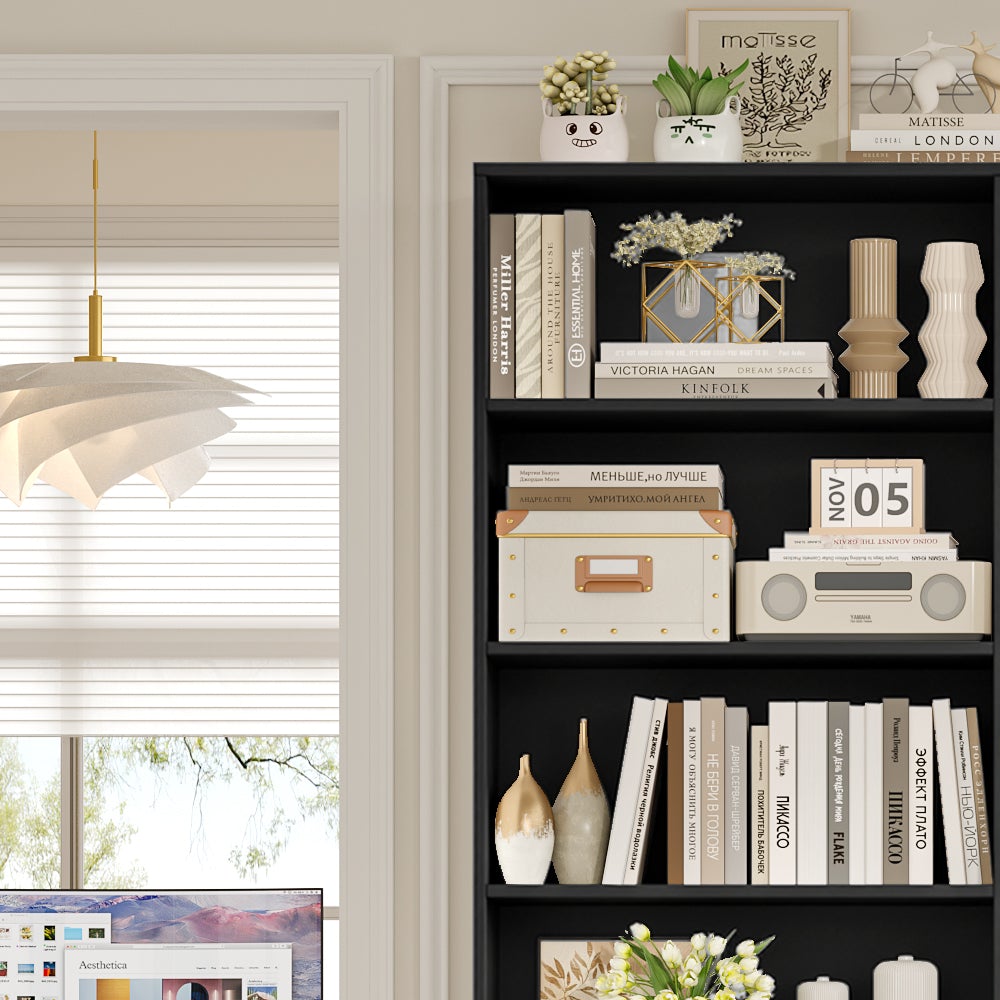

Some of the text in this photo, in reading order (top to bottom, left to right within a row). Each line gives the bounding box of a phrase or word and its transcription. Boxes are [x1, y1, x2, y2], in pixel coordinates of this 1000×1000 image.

[908, 116, 964, 127] MATISSE
[914, 135, 994, 146] LONDON
[571, 248, 581, 284] HOME
[500, 254, 512, 376] Miller Harris
[610, 366, 716, 376] VICTORIA HAGAN
[738, 366, 814, 375] DREAM SPACES
[682, 383, 750, 394] KINFOLK
[664, 471, 708, 482] ЛУЧШЕ
[672, 494, 705, 504] АНГЕЛ
[828, 477, 845, 521] NOV
[832, 538, 938, 546] GOING AGAINST THE GRAIN
[688, 734, 697, 760] МОГУ
[972, 745, 981, 775] РОСС
[688, 764, 697, 820] ОБЪЯСНИТЬ
[706, 752, 719, 860] НЕ БЕРИ В ГОЛОВУ
[915, 748, 927, 850] ЭФФЕКТ ПЛАТО
[629, 764, 655, 871] Религия черной водолазки
[757, 790, 765, 874] ПОХИТИТЕЛЬ БАБОЧЕК
[776, 796, 790, 850] ПИКАССО
[888, 790, 903, 864] ПИКАССО
[960, 786, 979, 869] НЬЮ-ЙОРК
[688, 822, 697, 860] МНОГОЕ
[833, 832, 845, 864] FLAKE
[79, 960, 127, 970] Aesthetica
